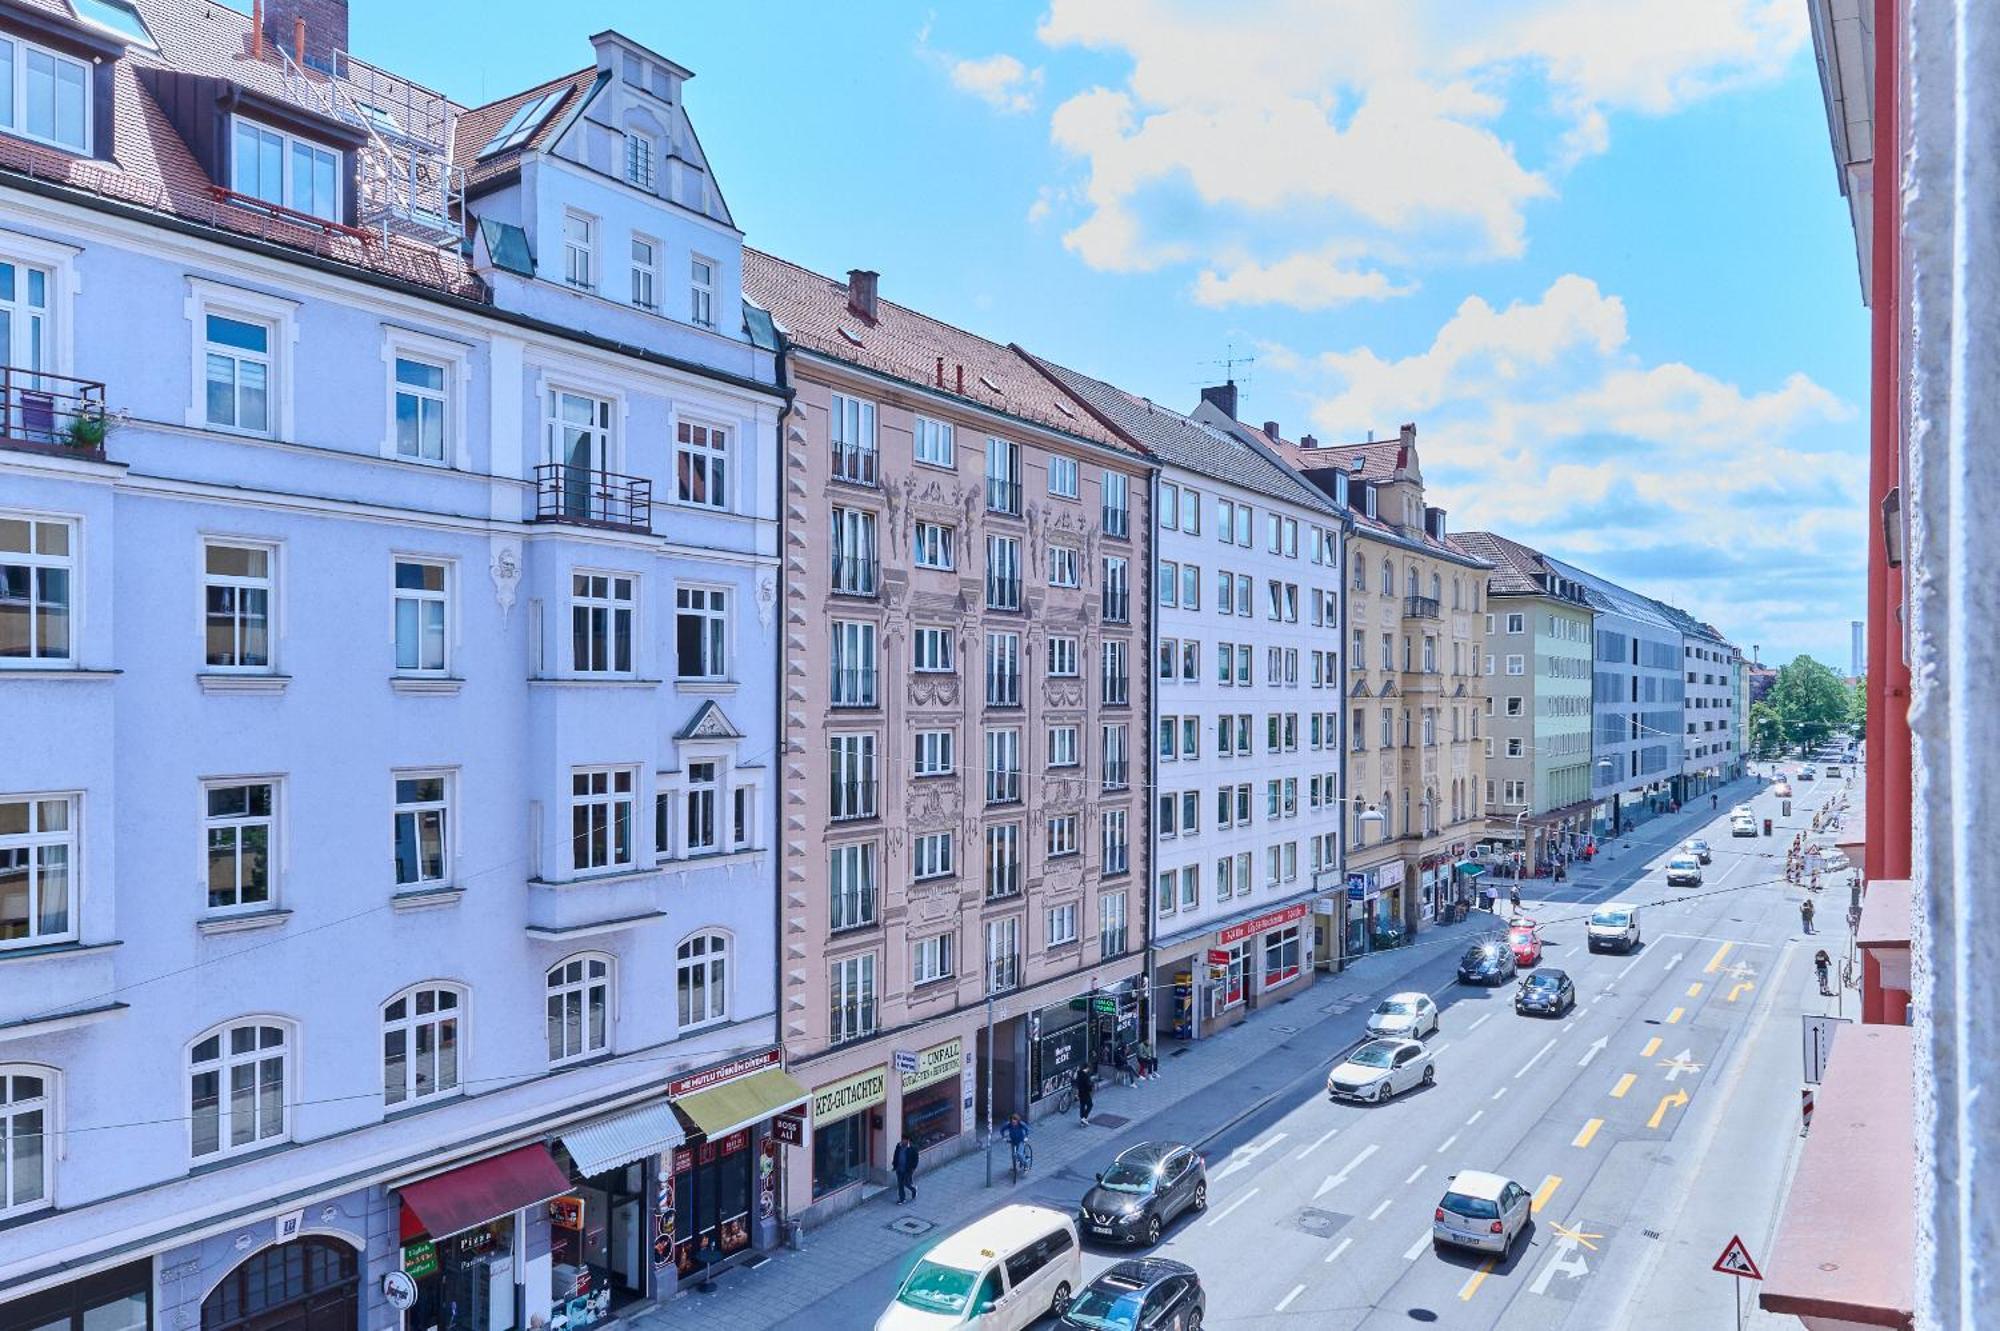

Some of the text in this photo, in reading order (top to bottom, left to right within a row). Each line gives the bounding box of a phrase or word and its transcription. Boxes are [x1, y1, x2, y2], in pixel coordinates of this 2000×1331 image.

[928, 1044, 960, 1065] UNFALL
[691, 1071, 716, 1087] MUTLU
[815, 1074, 884, 1117] KFZ-GUTACHTEN
[777, 1120, 797, 1132] BOSS
